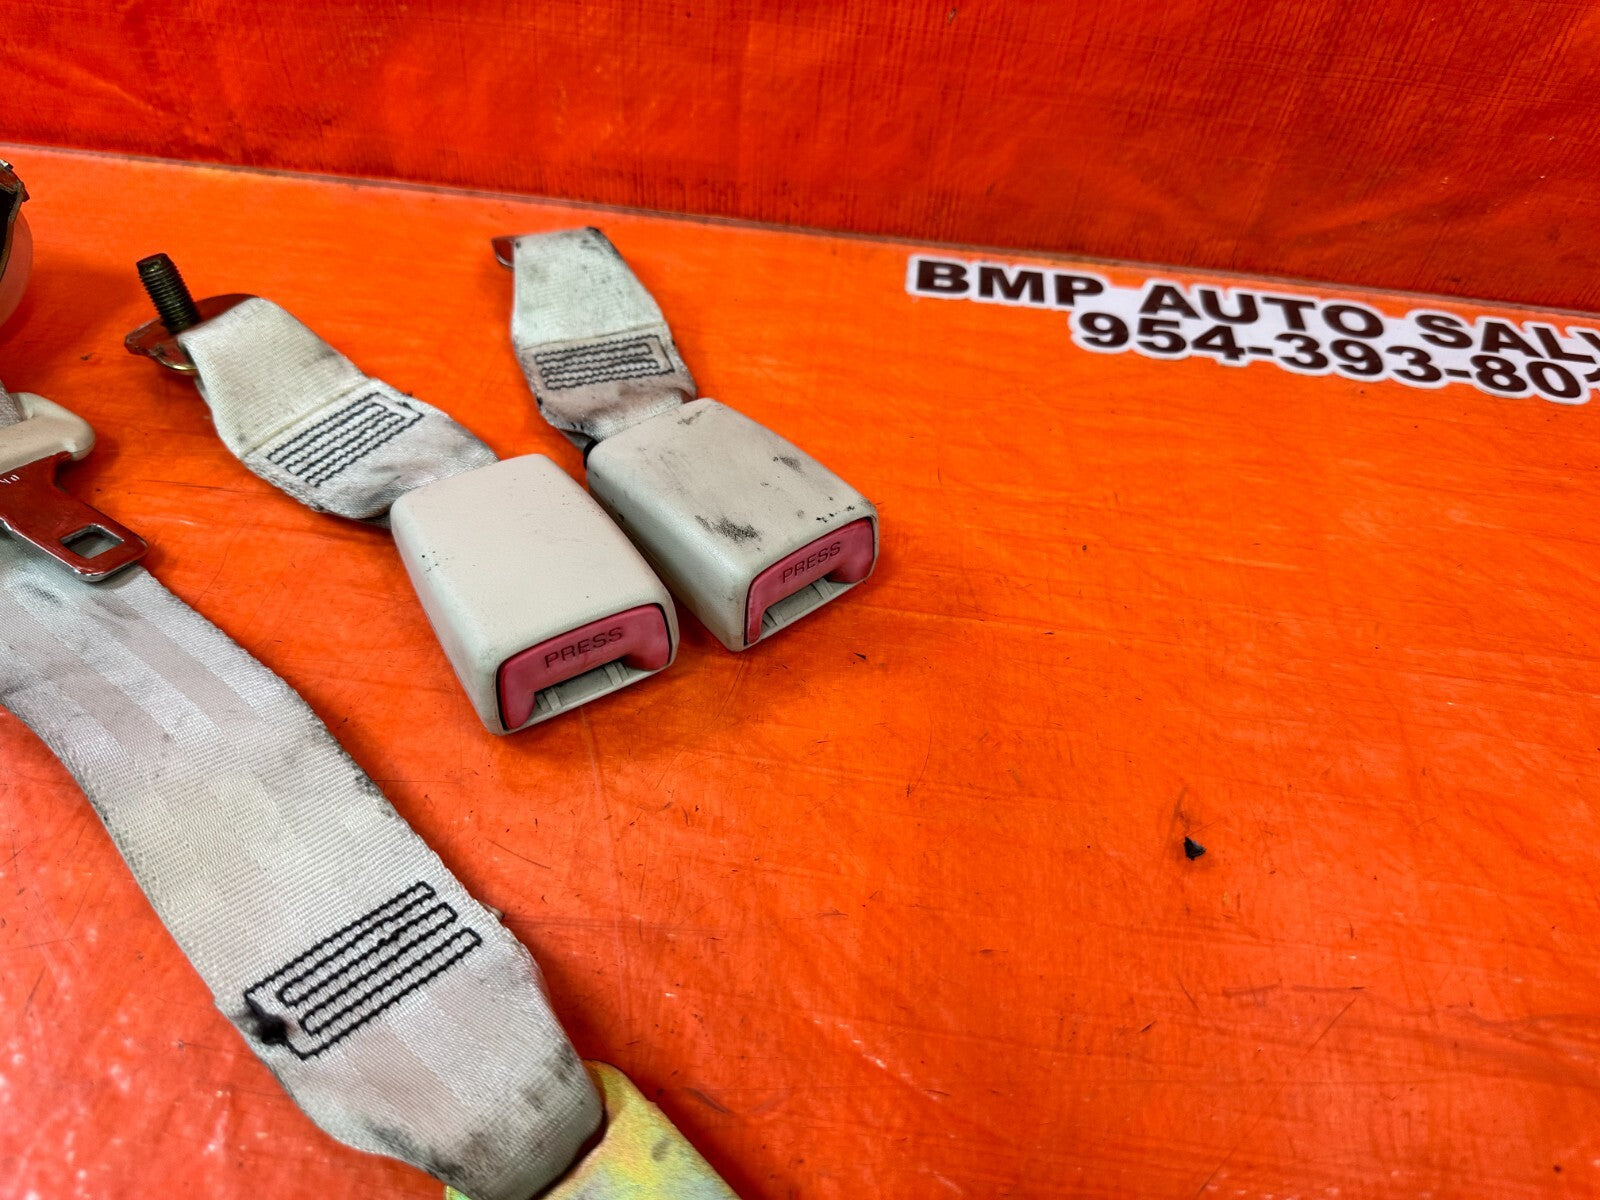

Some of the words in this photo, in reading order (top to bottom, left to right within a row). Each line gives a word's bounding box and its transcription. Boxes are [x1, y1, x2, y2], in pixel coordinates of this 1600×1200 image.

[917, 260, 1104, 307] BMP
[1139, 284, 1383, 339] AUTO
[1415, 314, 1600, 364] SAL
[1079, 311, 1600, 398] 954-393-80
[782, 541, 841, 583] PRESS
[544, 626, 624, 668] PRESS
